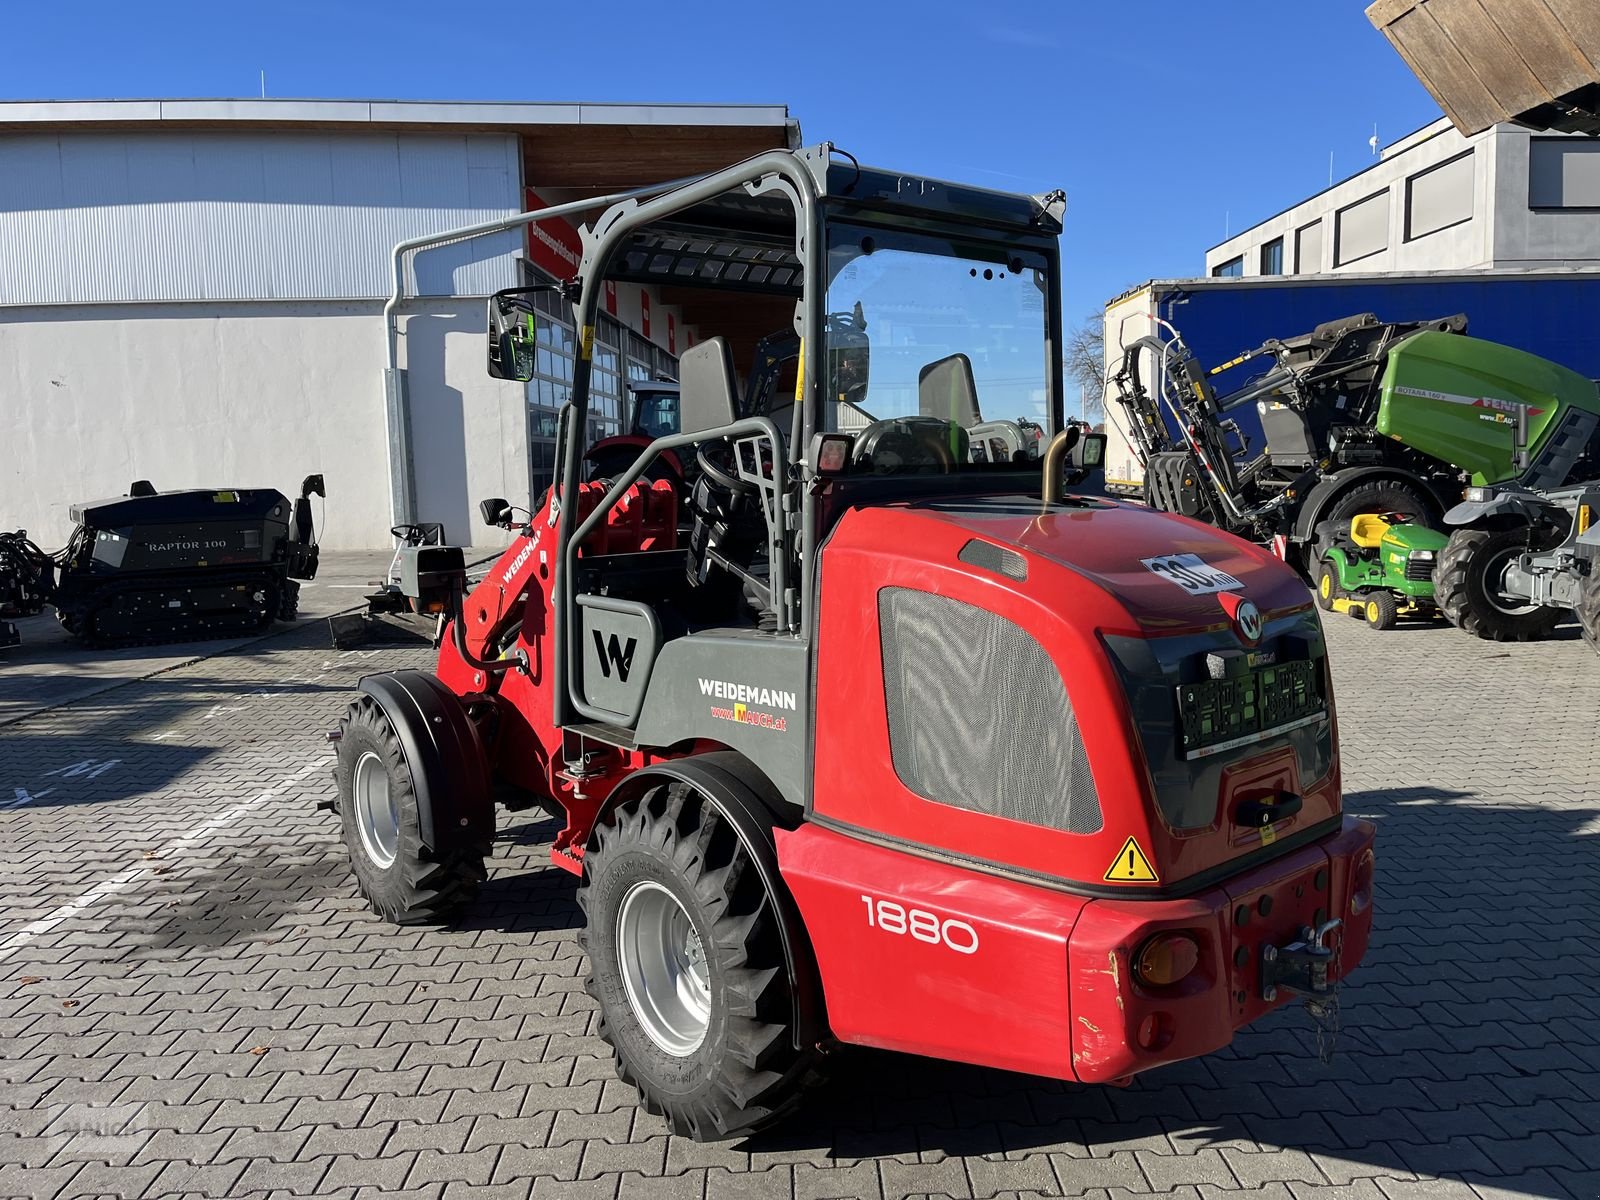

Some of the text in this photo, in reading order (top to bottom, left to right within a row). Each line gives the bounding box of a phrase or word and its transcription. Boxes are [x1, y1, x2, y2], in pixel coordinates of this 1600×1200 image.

[1398, 387, 1426, 396] ROTANA
[149, 540, 227, 552] RAPTOR 100
[1151, 561, 1237, 589] 30 km
[698, 678, 796, 711] WEIDEMANN
[710, 704, 787, 731] www.MAUCH.at
[861, 895, 979, 954] 1880
